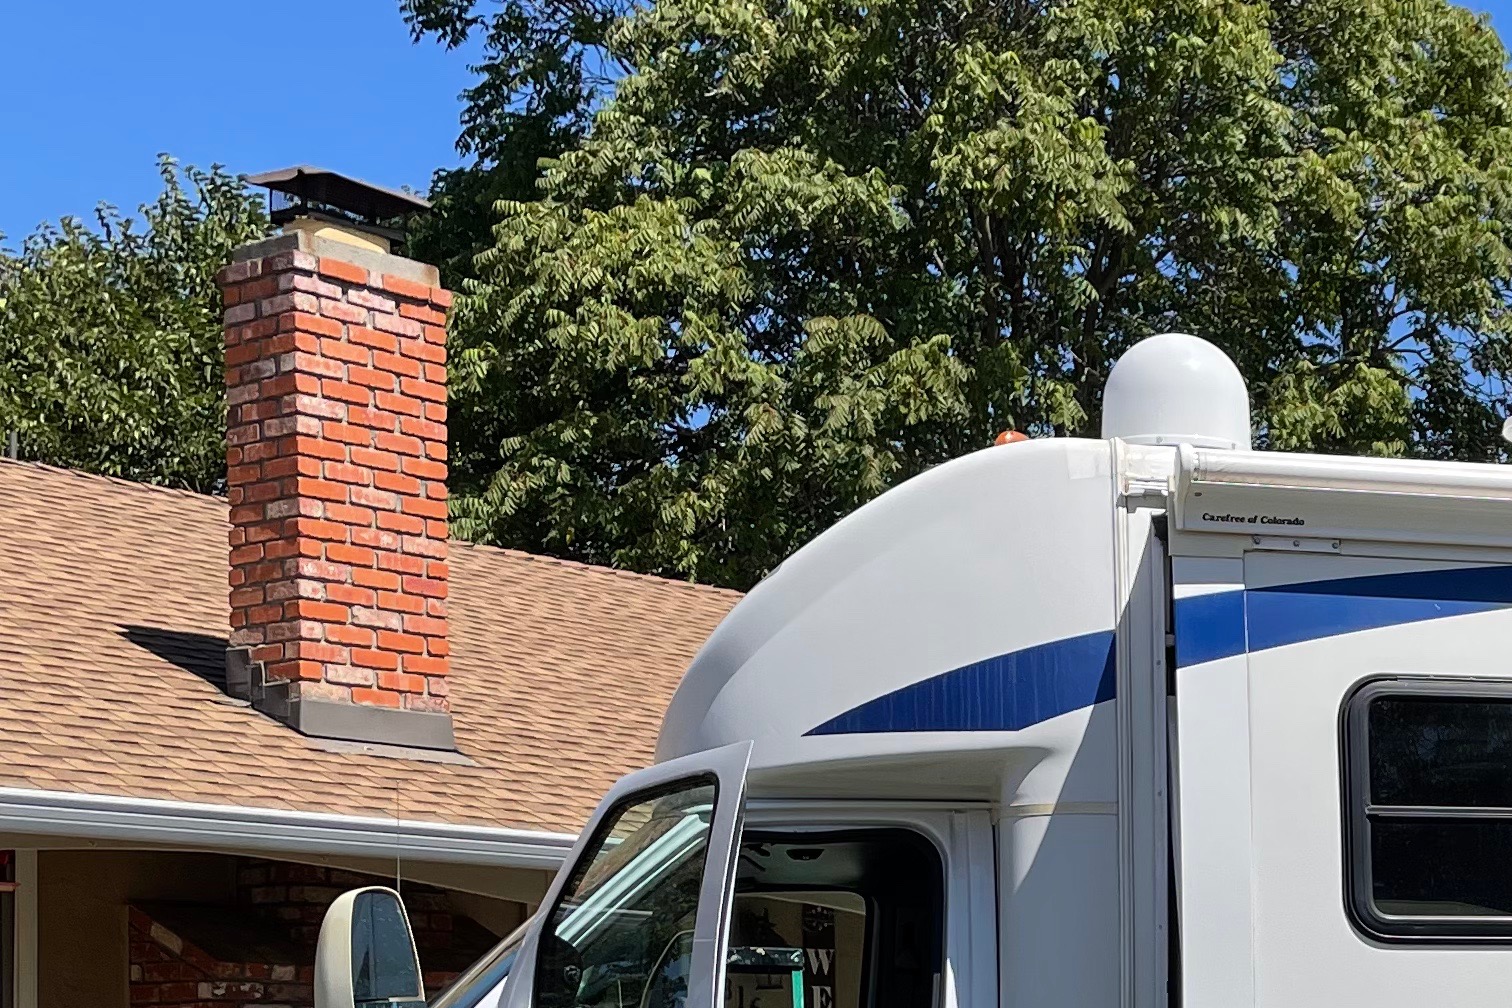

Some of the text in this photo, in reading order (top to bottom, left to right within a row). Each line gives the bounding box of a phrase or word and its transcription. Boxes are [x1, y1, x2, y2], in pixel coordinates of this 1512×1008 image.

[1202, 513, 1305, 526] Carefree of Colorado
